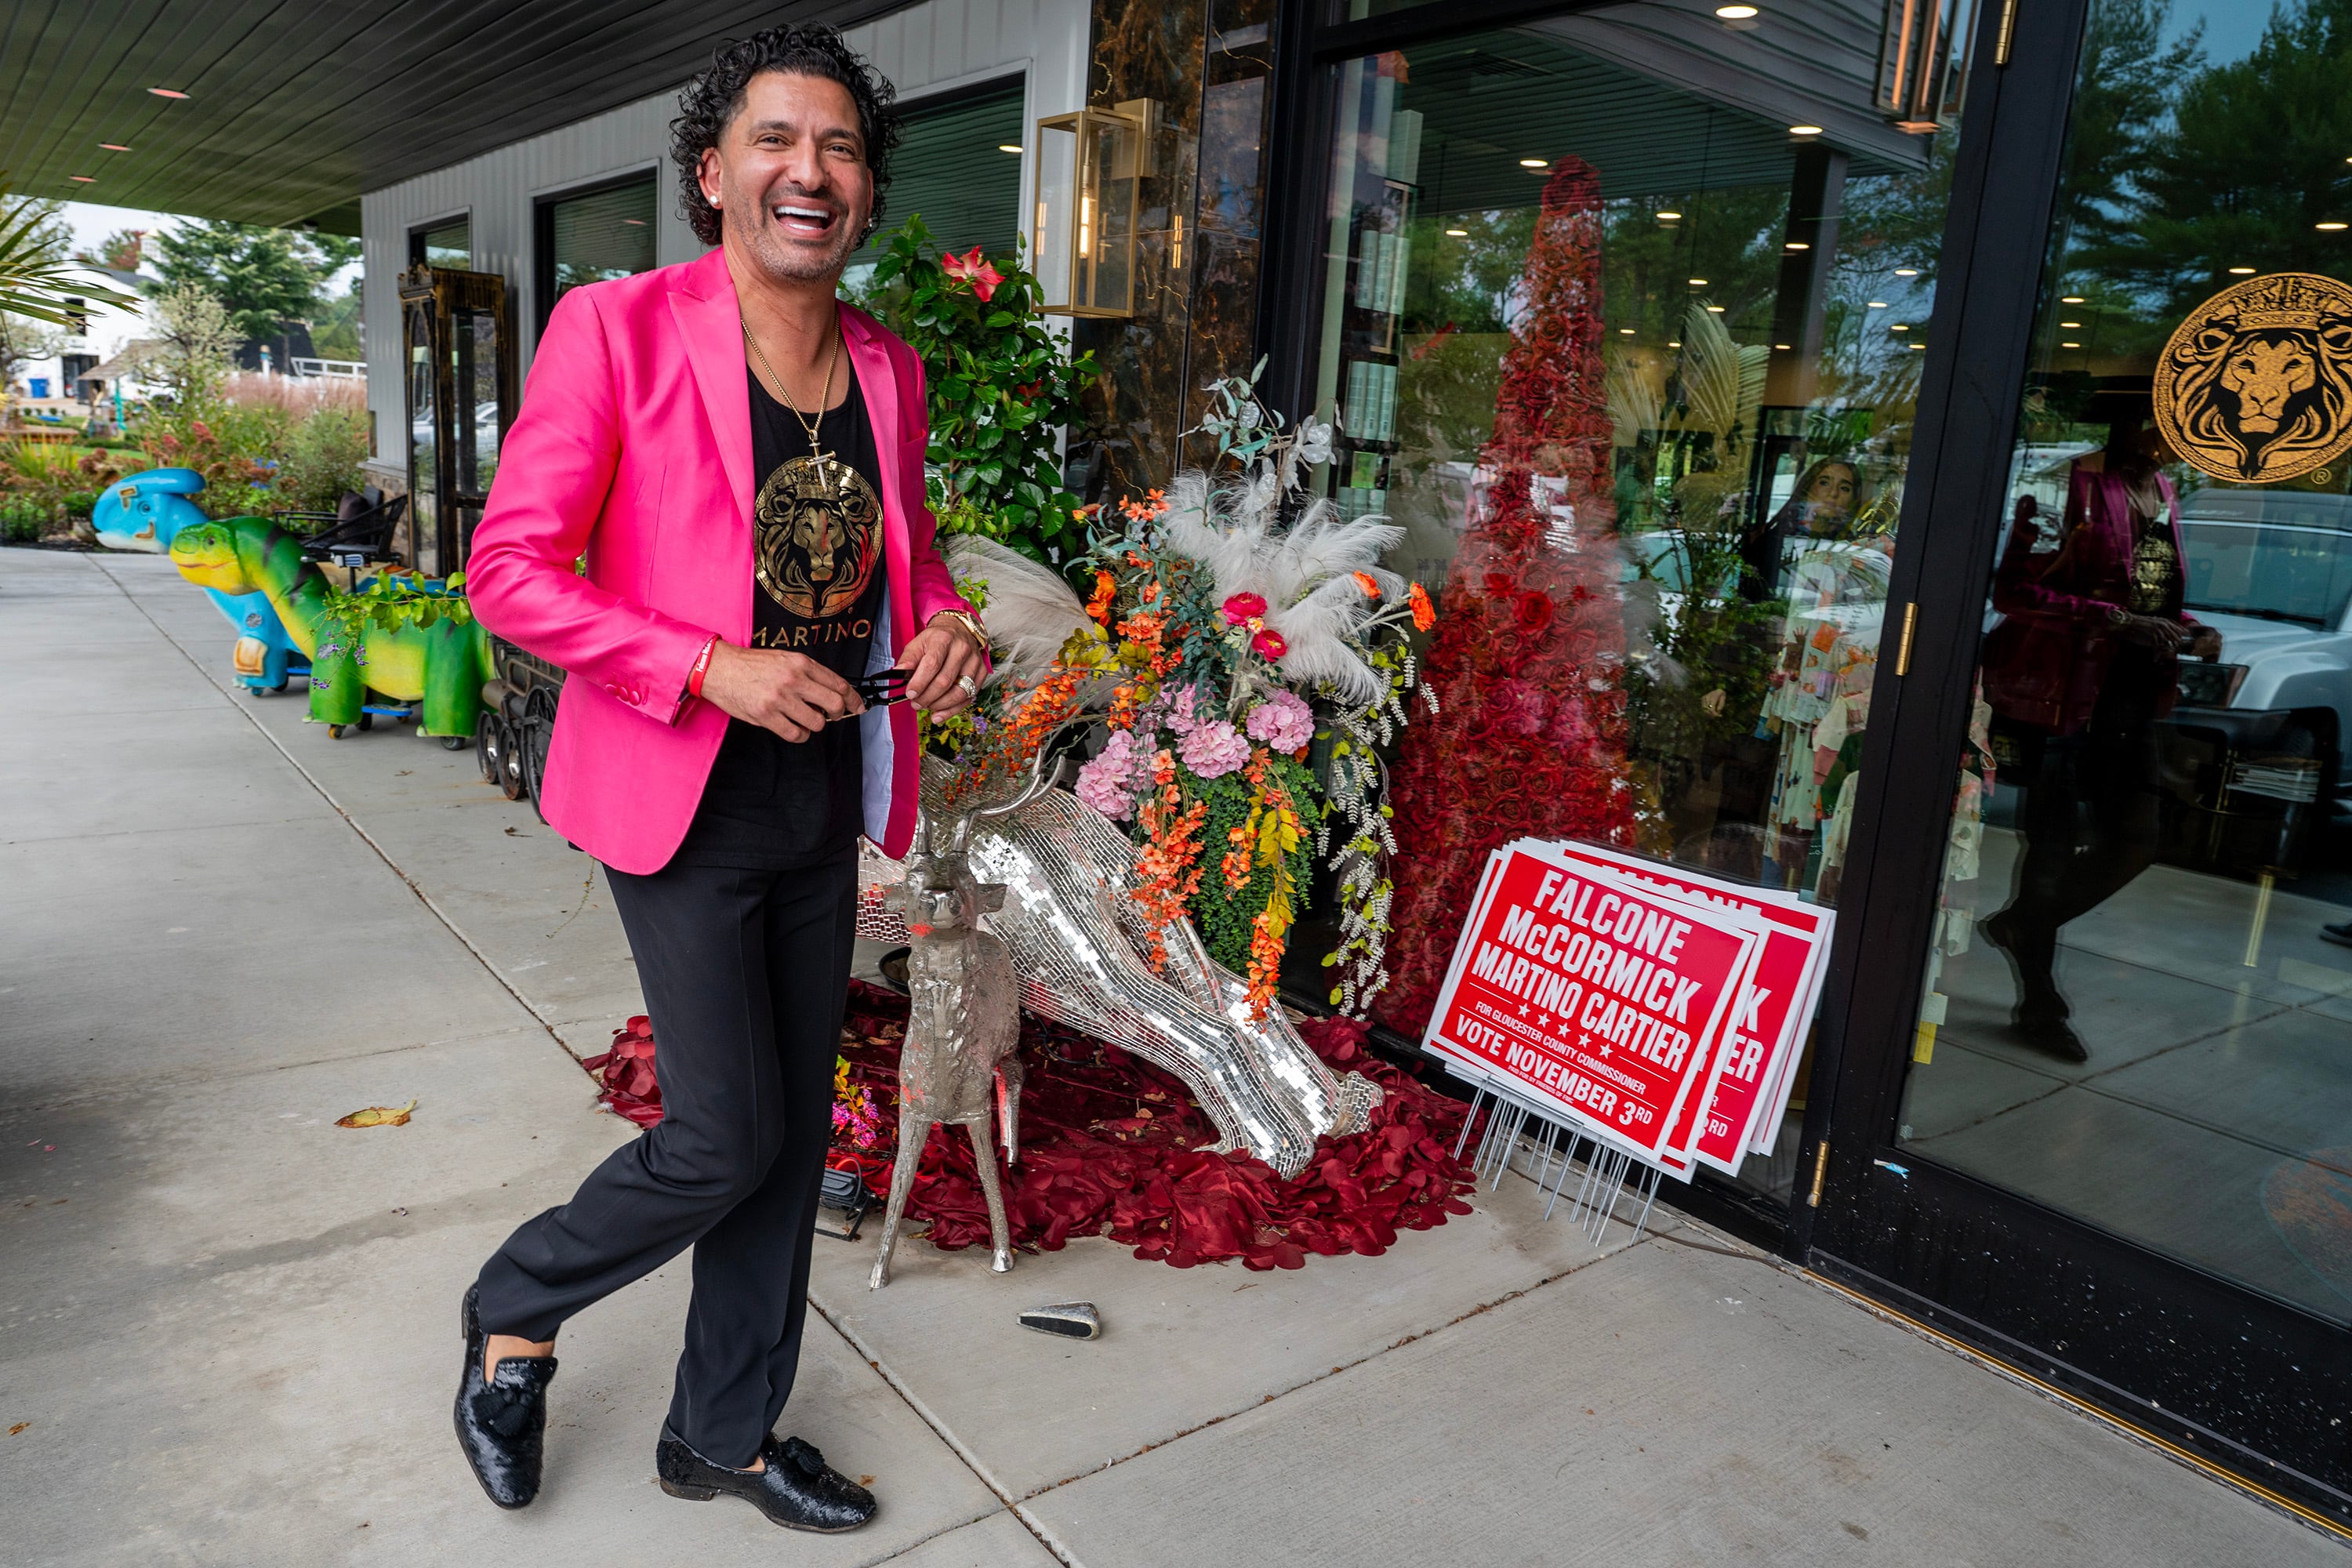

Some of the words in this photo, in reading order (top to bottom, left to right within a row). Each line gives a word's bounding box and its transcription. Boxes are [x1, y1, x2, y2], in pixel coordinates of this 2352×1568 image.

[1498, 904, 1702, 1024] McCORMICK
[1533, 869, 1693, 965] FALCONE
[1472, 941, 1583, 1019] MARTINO
[1580, 992, 1691, 1073] CARTIER
[1475, 1000, 1493, 1017] FOR
[1492, 1009, 1544, 1043] GLOUCESTER
[1542, 1035, 1578, 1059] COUNTY
[1577, 1052, 1646, 1095] COMMISSIONER
[1456, 1014, 1505, 1057] VOTE
[1504, 1041, 1618, 1117] NOVEMBER
[1618, 1101, 1653, 1126] 3RD
[1519, 1070, 1530, 1080] FOR
